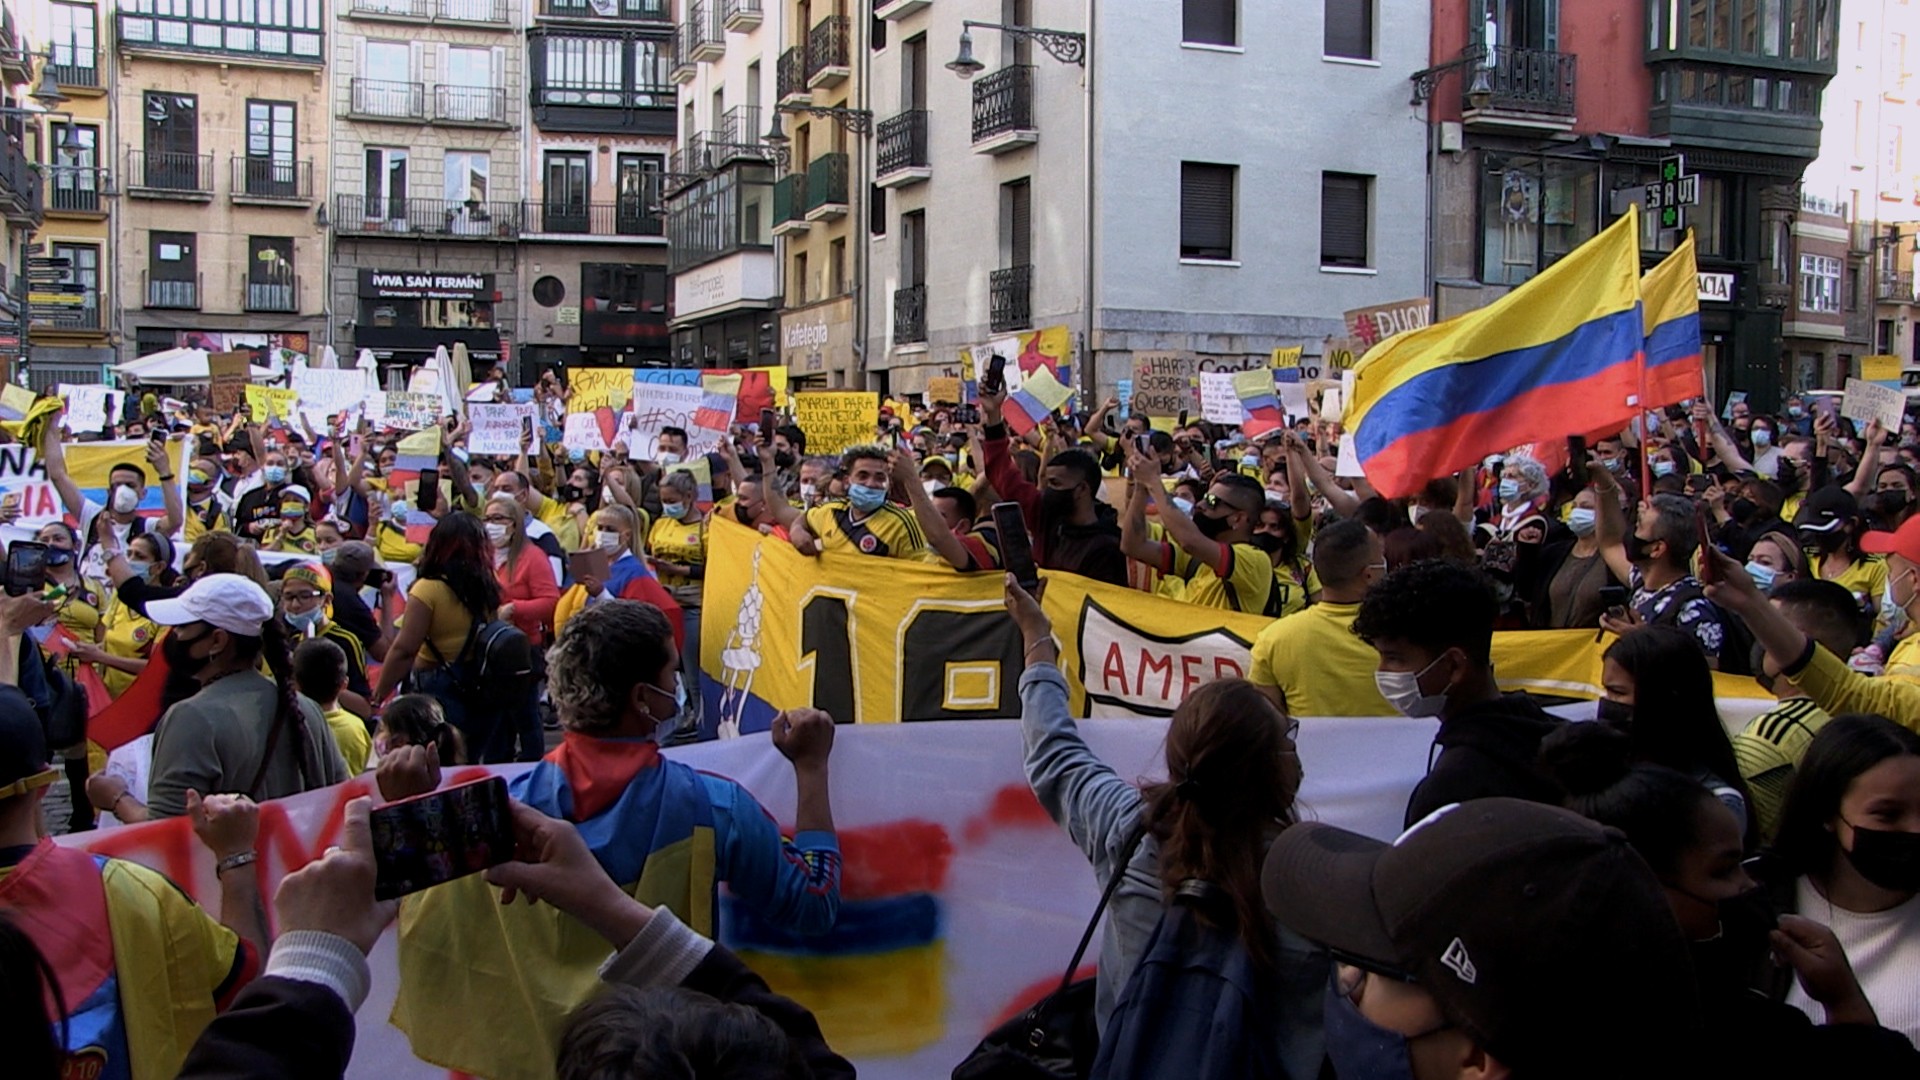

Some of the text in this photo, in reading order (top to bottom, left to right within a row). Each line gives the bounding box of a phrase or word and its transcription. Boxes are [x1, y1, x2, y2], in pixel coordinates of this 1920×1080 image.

[407, 276, 432, 287] SAN
[436, 274, 483, 289] FERMÍN!
[784, 320, 827, 350] Kafetegia
[1330, 349, 1351, 369] NO
[798, 396, 874, 410] MARCHO PARA
[473, 406, 481, 418] A
[830, 409, 864, 422] MEJOR
[836, 424, 849, 435] DE
